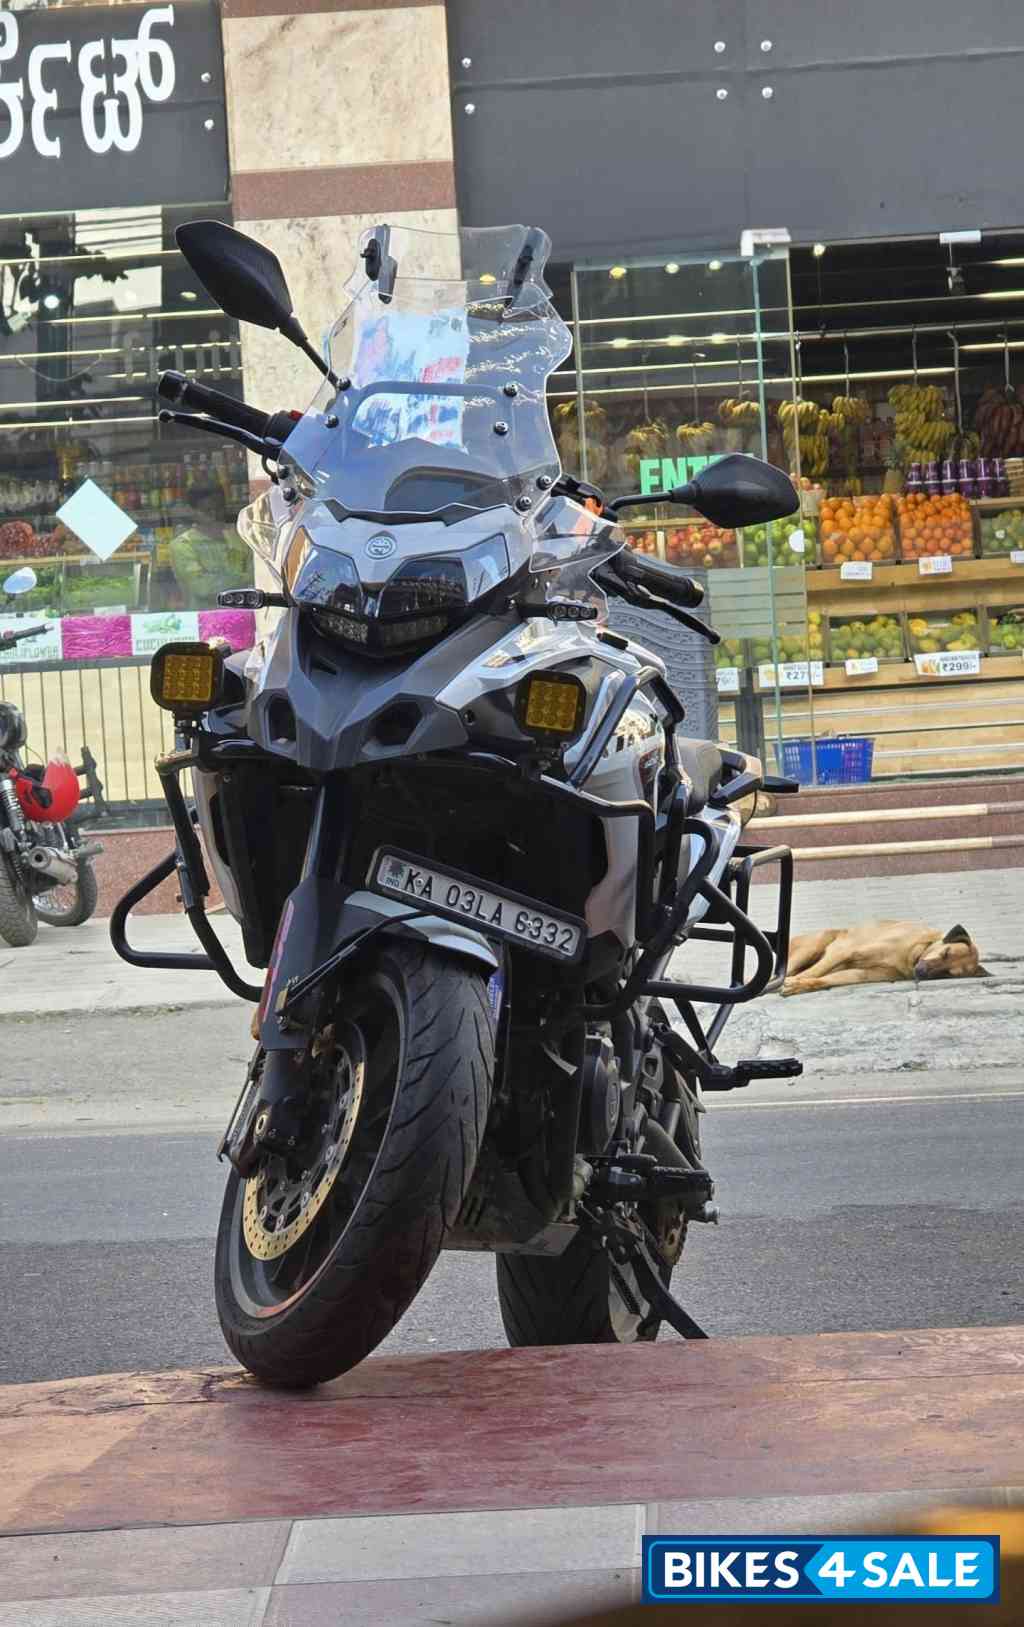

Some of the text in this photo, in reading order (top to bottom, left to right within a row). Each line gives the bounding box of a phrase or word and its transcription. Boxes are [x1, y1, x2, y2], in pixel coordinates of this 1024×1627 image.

[640, 455, 723, 496] ENT
[404, 868, 575, 951] KA 03LA 6332
